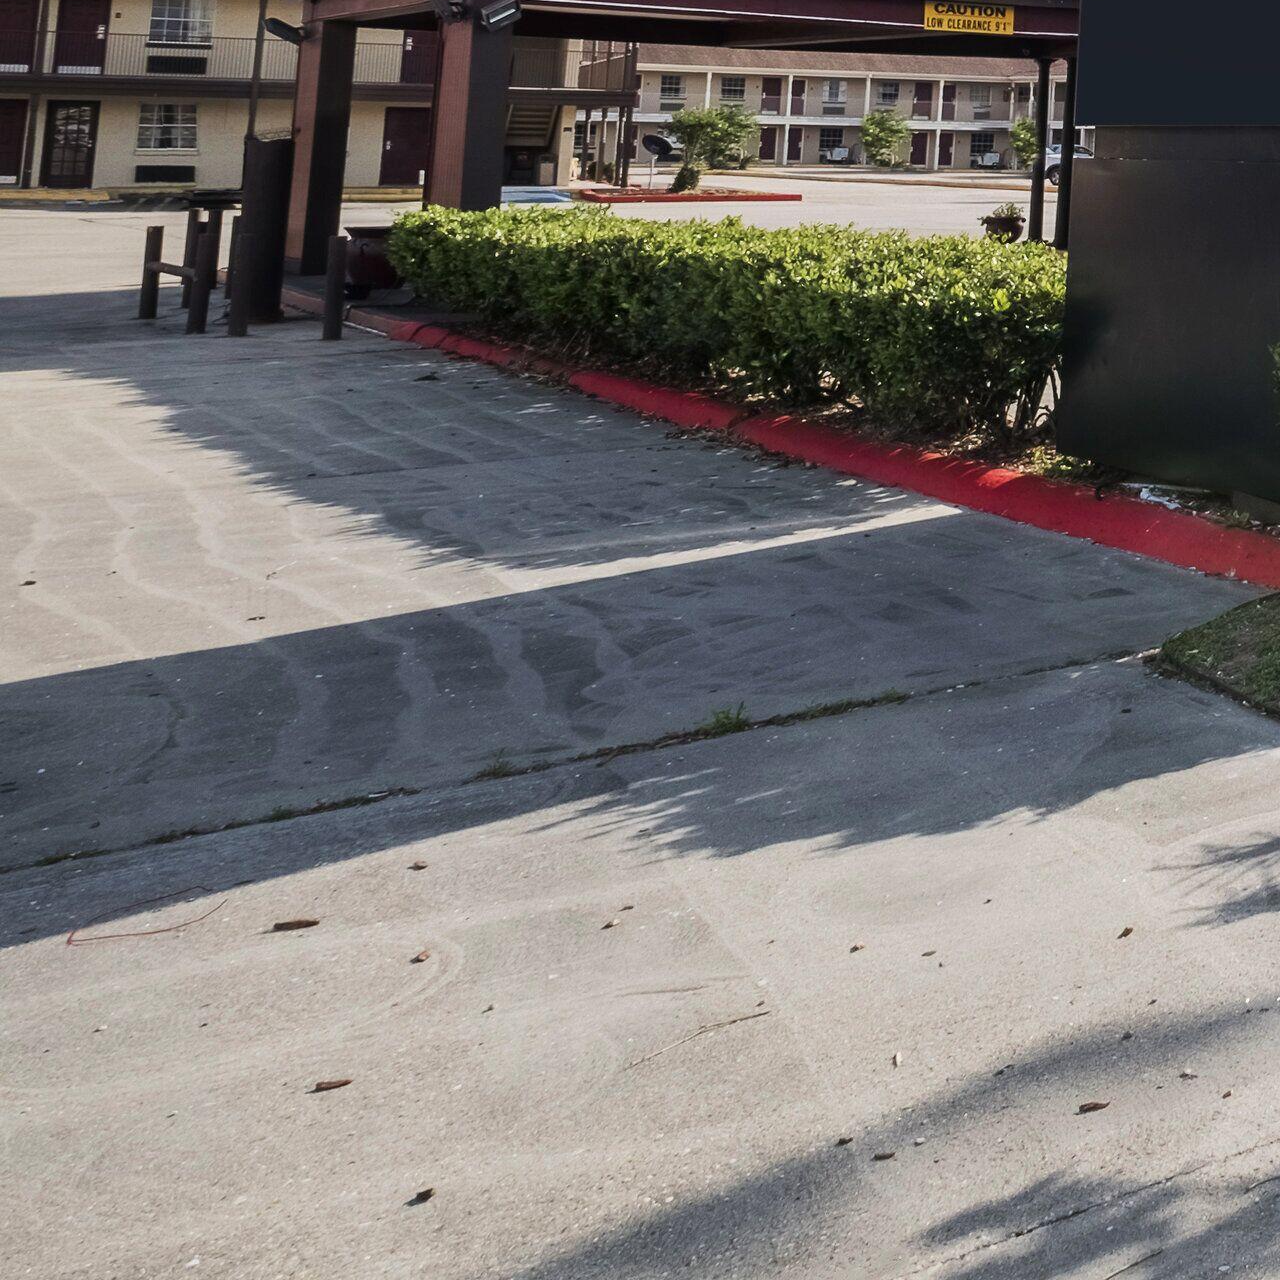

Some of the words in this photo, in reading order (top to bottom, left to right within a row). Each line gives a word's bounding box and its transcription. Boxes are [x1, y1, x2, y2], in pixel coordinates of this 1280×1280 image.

[934, 2, 1006, 18] CAUTION
[926, 17, 943, 28] LOW
[947, 18, 992, 32] CLEARANCE
